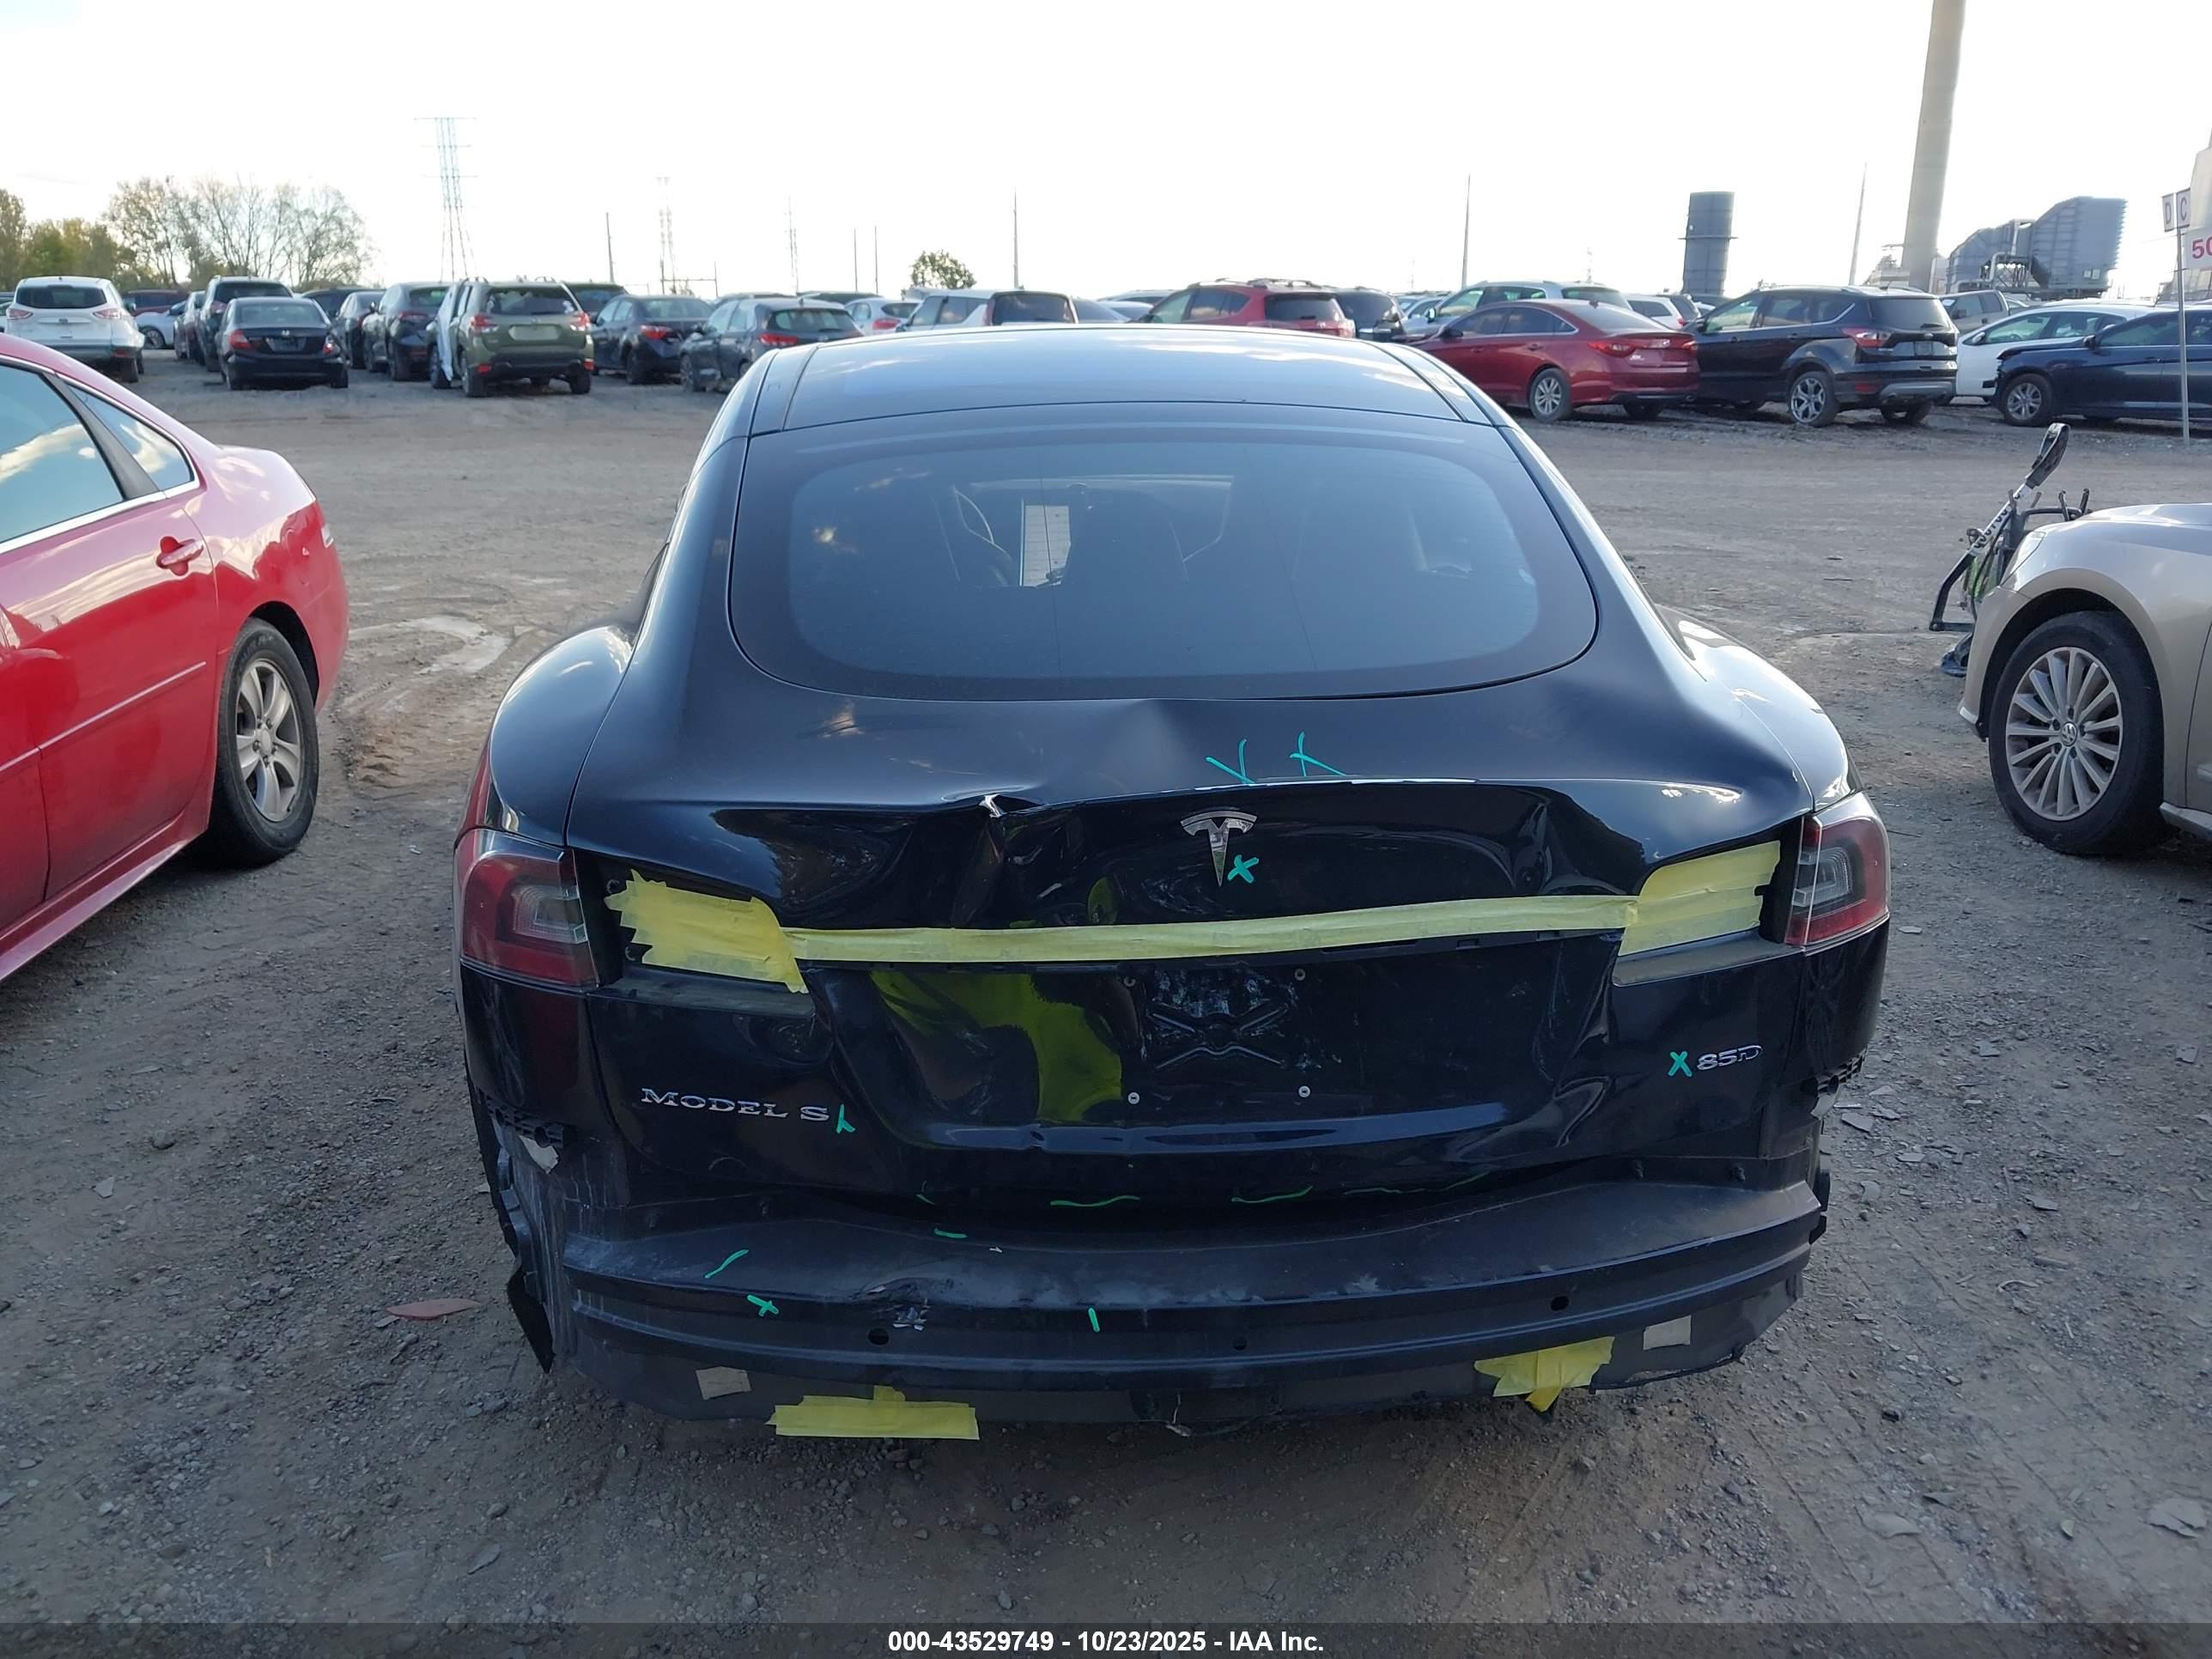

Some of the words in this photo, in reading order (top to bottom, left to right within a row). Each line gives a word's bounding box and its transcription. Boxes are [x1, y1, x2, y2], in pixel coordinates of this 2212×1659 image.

[2165, 202, 2172, 224] D
[2180, 196, 2187, 221] C
[1697, 1045, 1763, 1070] 85D
[641, 1088, 789, 1118] MODEL
[799, 1106, 830, 1121] S
